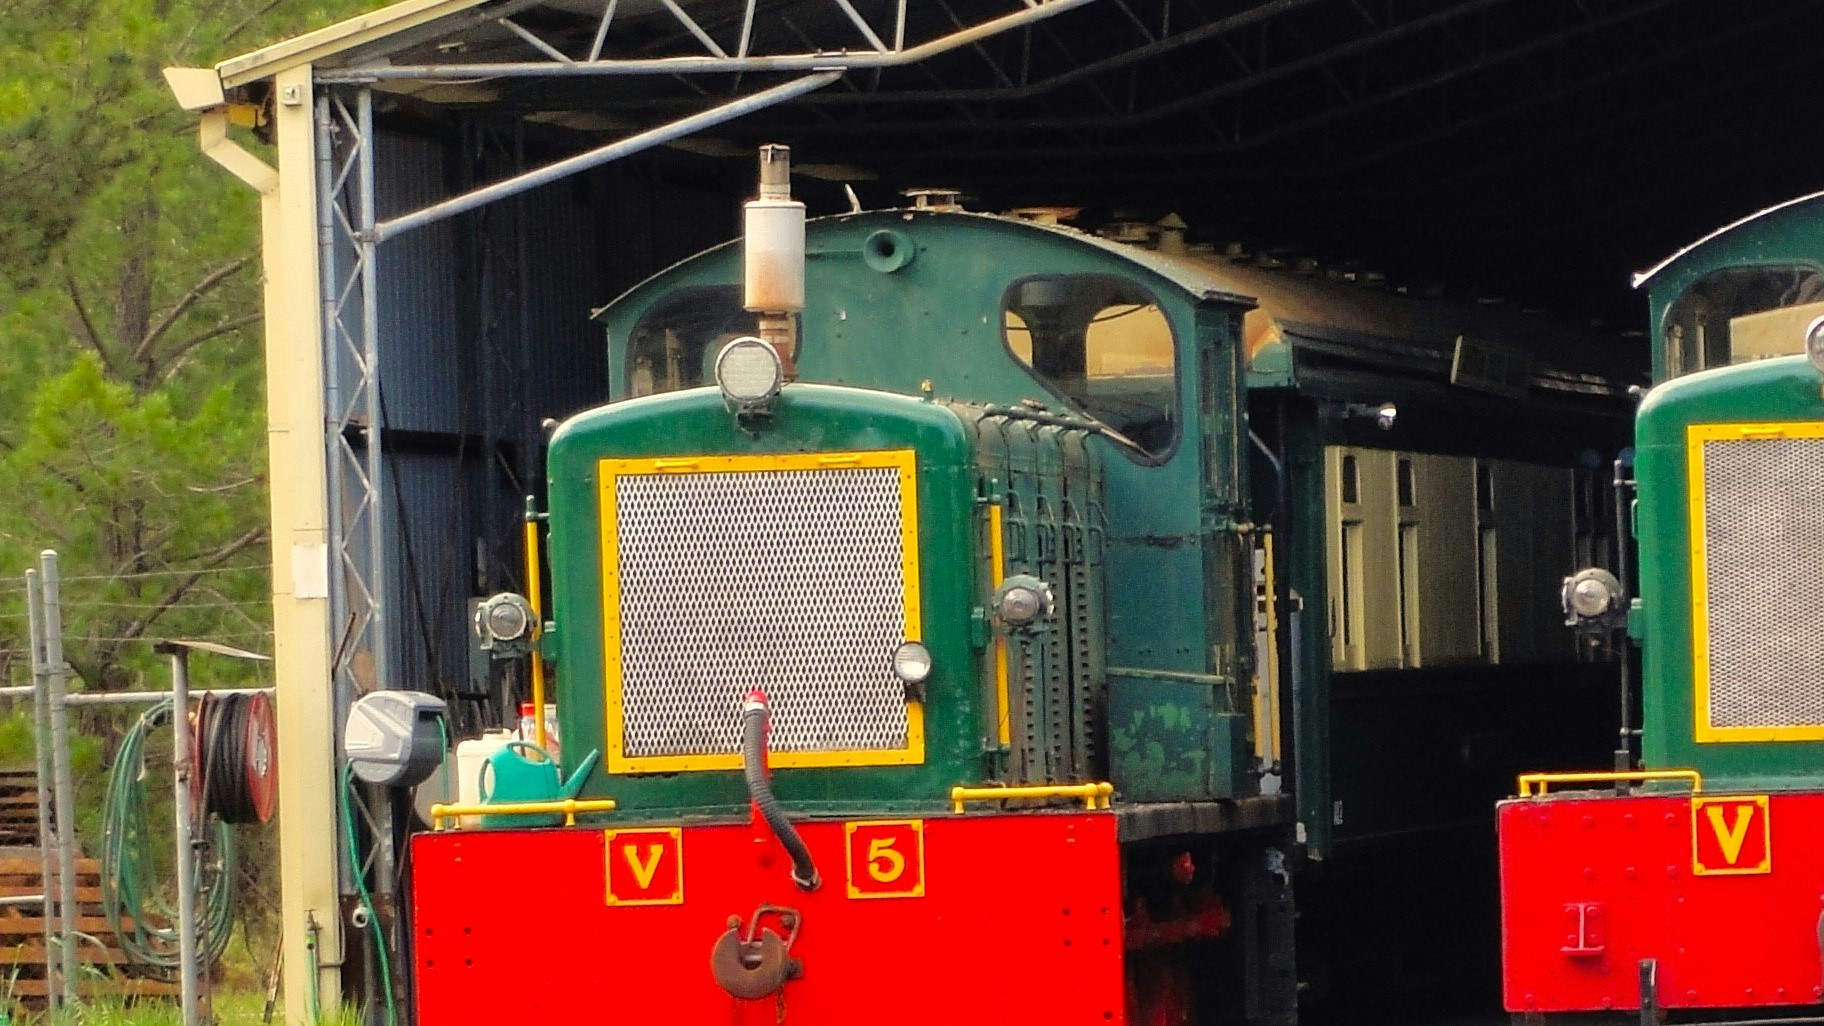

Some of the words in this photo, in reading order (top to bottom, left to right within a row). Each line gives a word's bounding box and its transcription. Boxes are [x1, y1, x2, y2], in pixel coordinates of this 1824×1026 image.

[623, 843, 665, 890] V
[867, 836, 905, 883] 5
[1706, 804, 1754, 865] V
